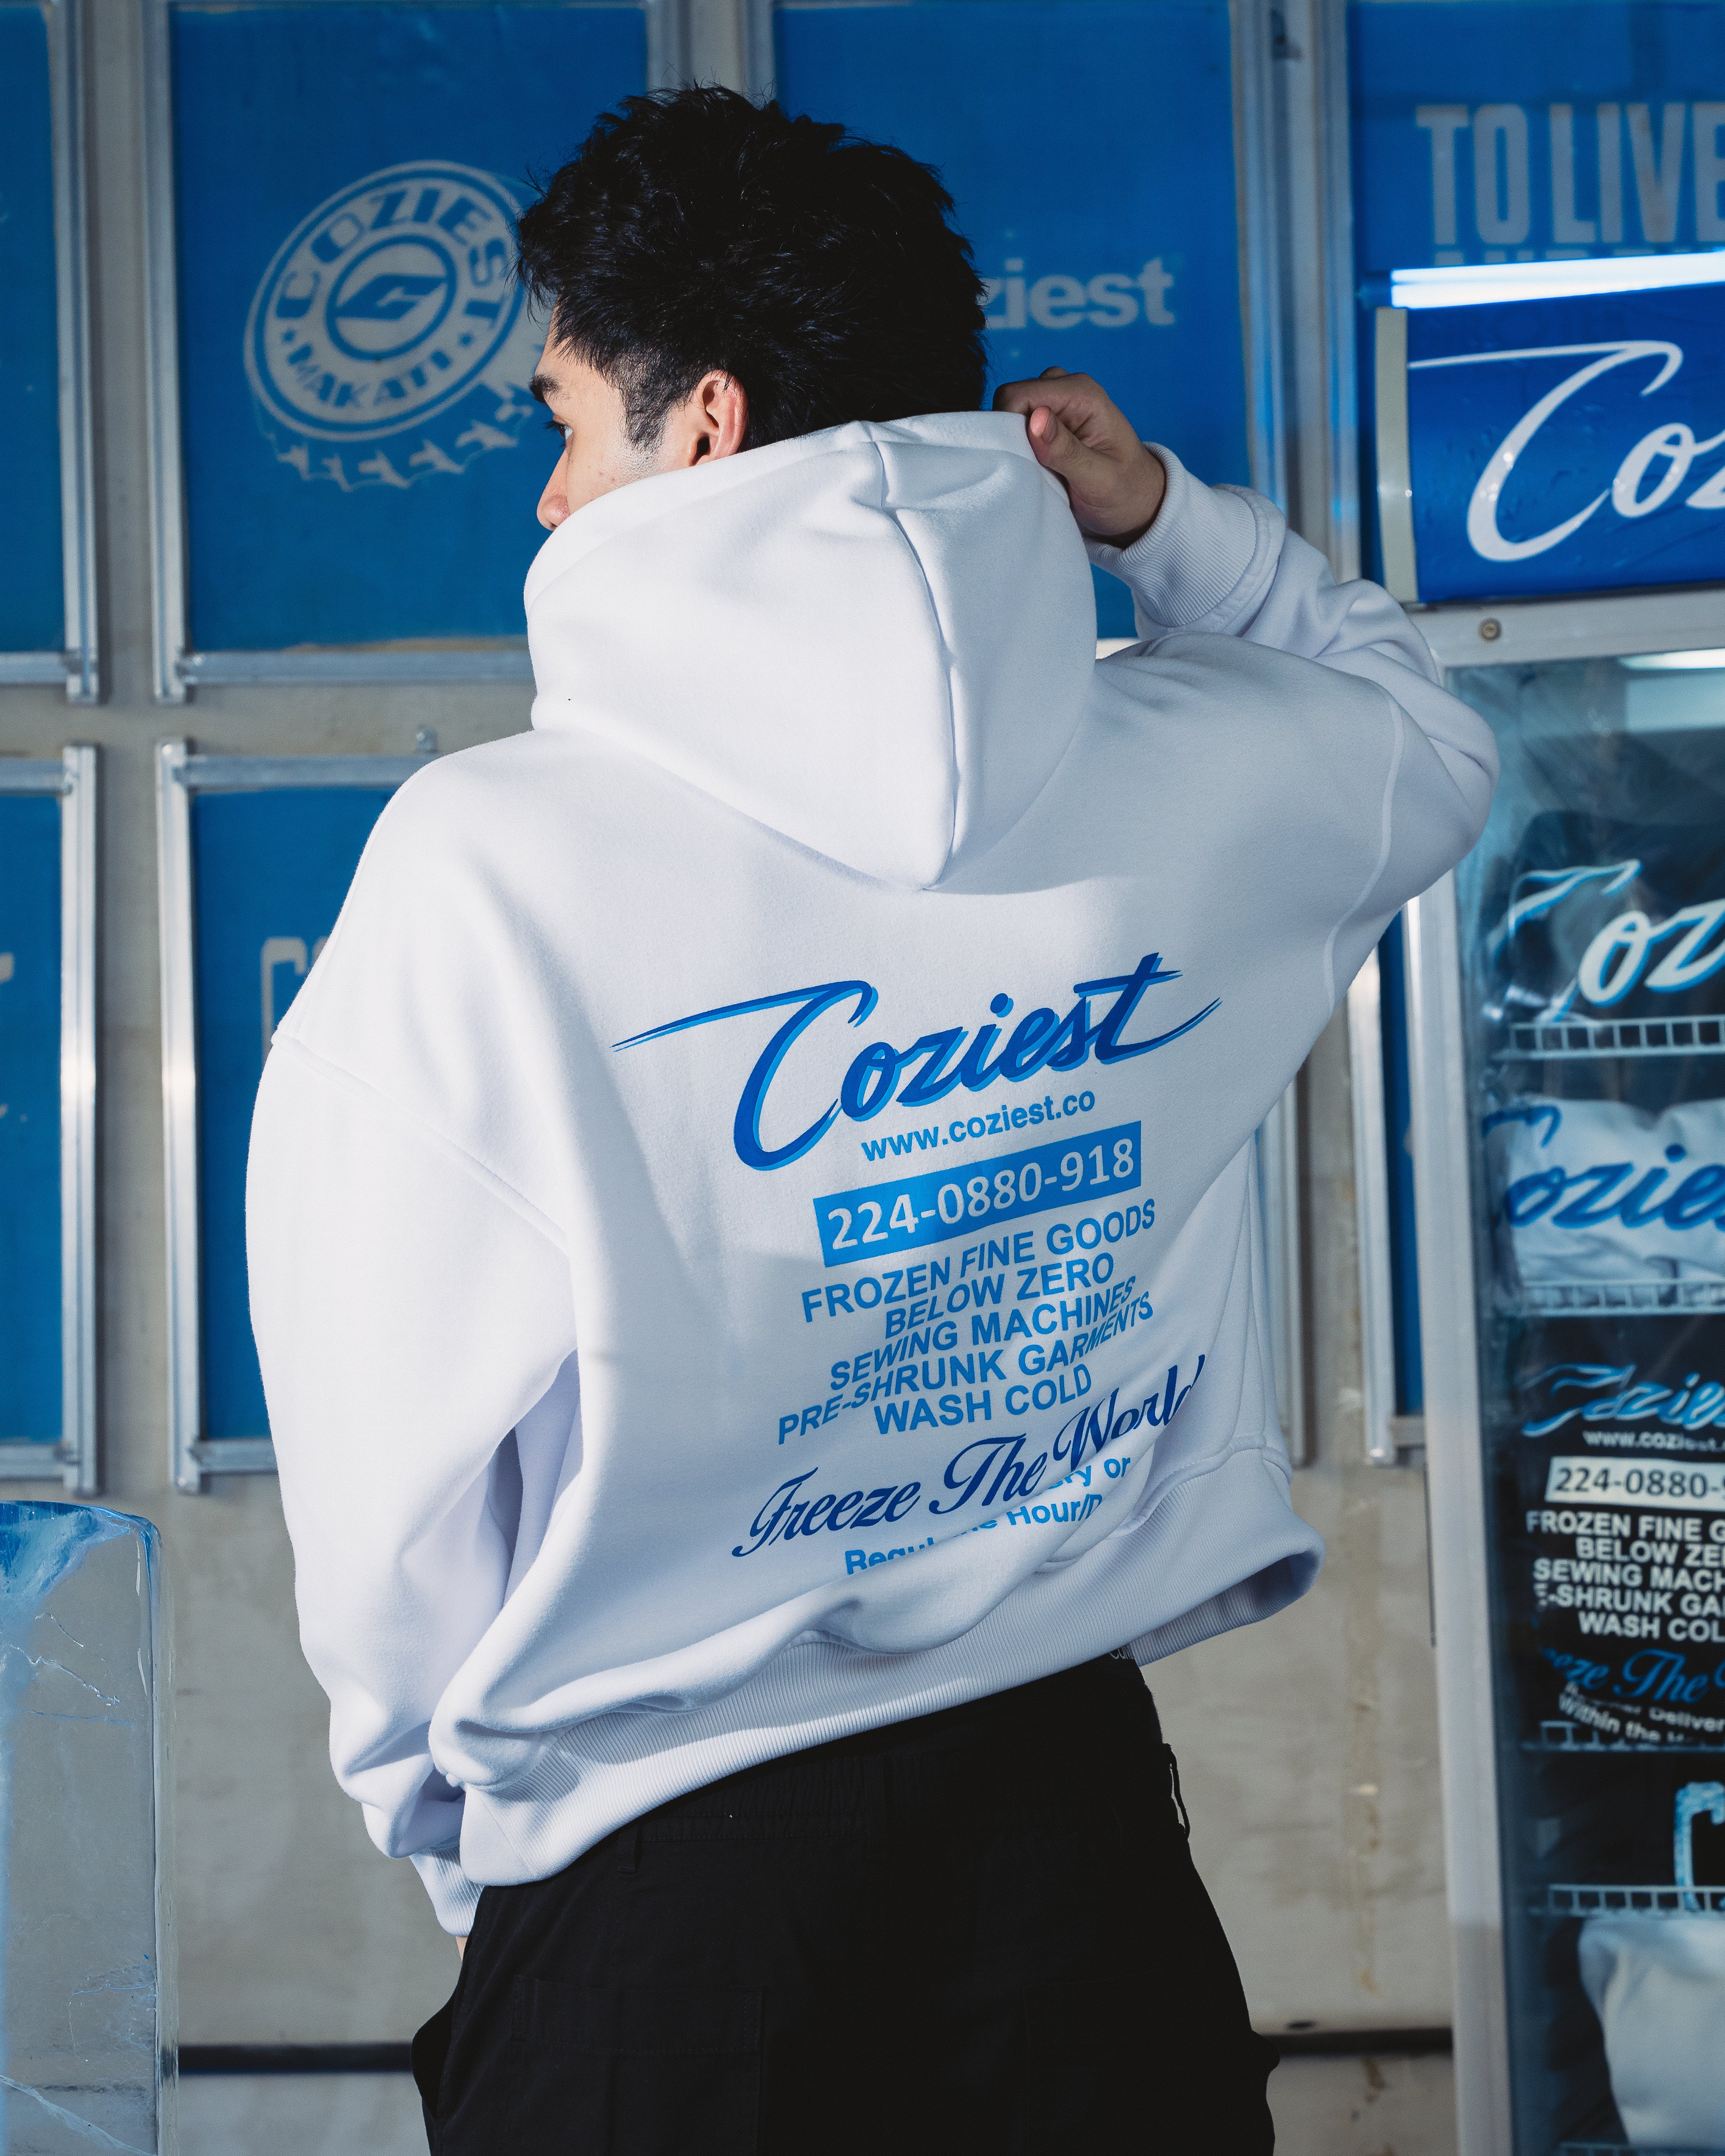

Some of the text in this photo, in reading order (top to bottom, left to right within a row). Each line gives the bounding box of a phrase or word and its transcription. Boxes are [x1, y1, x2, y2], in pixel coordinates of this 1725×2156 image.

[1415, 103, 1530, 245] TO
[275, 188, 507, 331] COZIEST
[610, 952, 1221, 1171] Coziest
[861, 1091, 1096, 1162] www.coziest.co
[826, 1138, 1135, 1251] 224-0880-918
[802, 1198, 1155, 1322] FROZEN FINE GOODS
[884, 1252, 1114, 1338] BELOW ZERO
[778, 1291, 1154, 1444] PRE-SHRUNK GARMENTS
[830, 1276, 1136, 1390] SEWING MACHINES
[873, 1364, 1092, 1435] WASH COLD
[732, 1467, 921, 1557] Freeze
[929, 1433, 1047, 1515] The
[1103, 1457, 1131, 1478] or
[1556, 1466, 1725, 1498] 224-0880-
[1525, 1510, 1631, 1537] FROZEN
[1639, 1515, 1703, 1541] FINE
[1575, 1537, 1679, 1565] BELOW
[1533, 1558, 1642, 1587] SEWING
[1578, 1611, 1661, 1639] WASH
[1612, 1648, 1710, 1704] The
